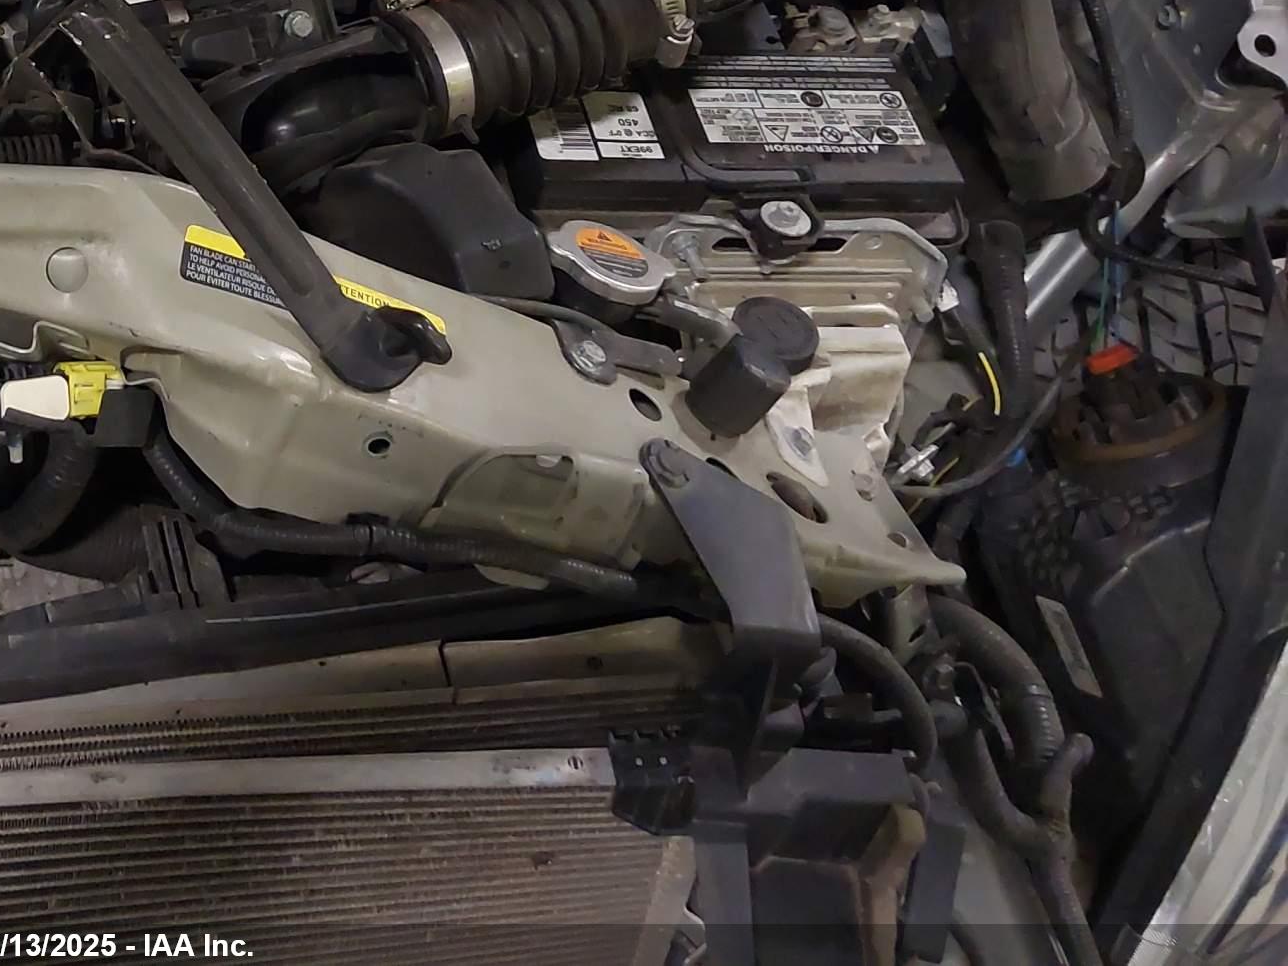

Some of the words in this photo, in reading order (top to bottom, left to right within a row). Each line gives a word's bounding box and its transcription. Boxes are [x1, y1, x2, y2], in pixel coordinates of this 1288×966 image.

[190, 245, 203, 255] FAN
[203, 249, 223, 262] BLADE
[224, 255, 236, 266] CAN
[235, 260, 255, 272] START
[190, 253, 198, 262] TO
[199, 256, 215, 266] HELP
[215, 262, 235, 273] AVOID
[236, 268, 266, 283] PERSONA
[186, 269, 206, 280] POUR
[231, 283, 252, 296] TOUTE
[187, 261, 196, 270] LE
[197, 264, 241, 283] VENTILATEUR
[242, 278, 266, 292] RISQUE
